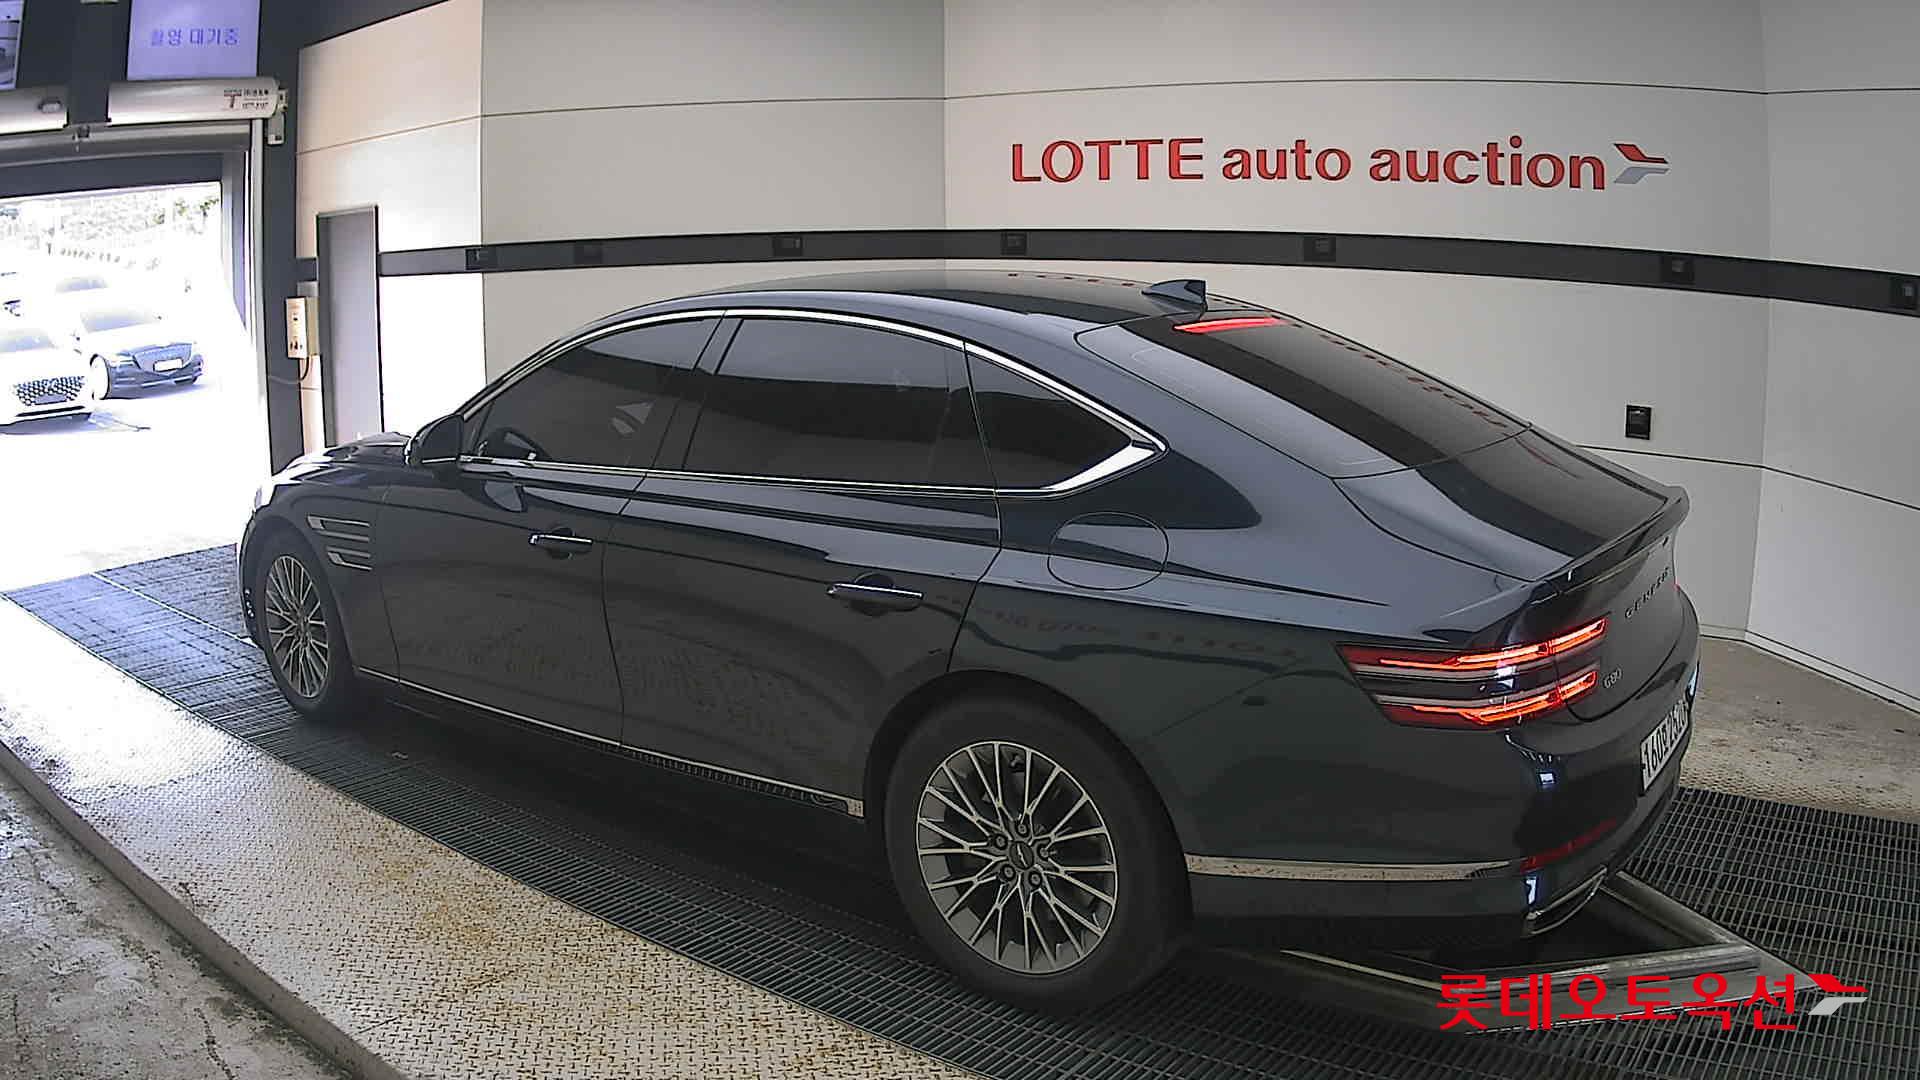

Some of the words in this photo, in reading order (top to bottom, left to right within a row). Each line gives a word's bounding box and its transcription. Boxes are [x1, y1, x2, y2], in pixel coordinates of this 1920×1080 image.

[1012, 138, 1203, 183] LOTTE
[1223, 140, 1352, 181] auto
[1369, 135, 1606, 190] auction
